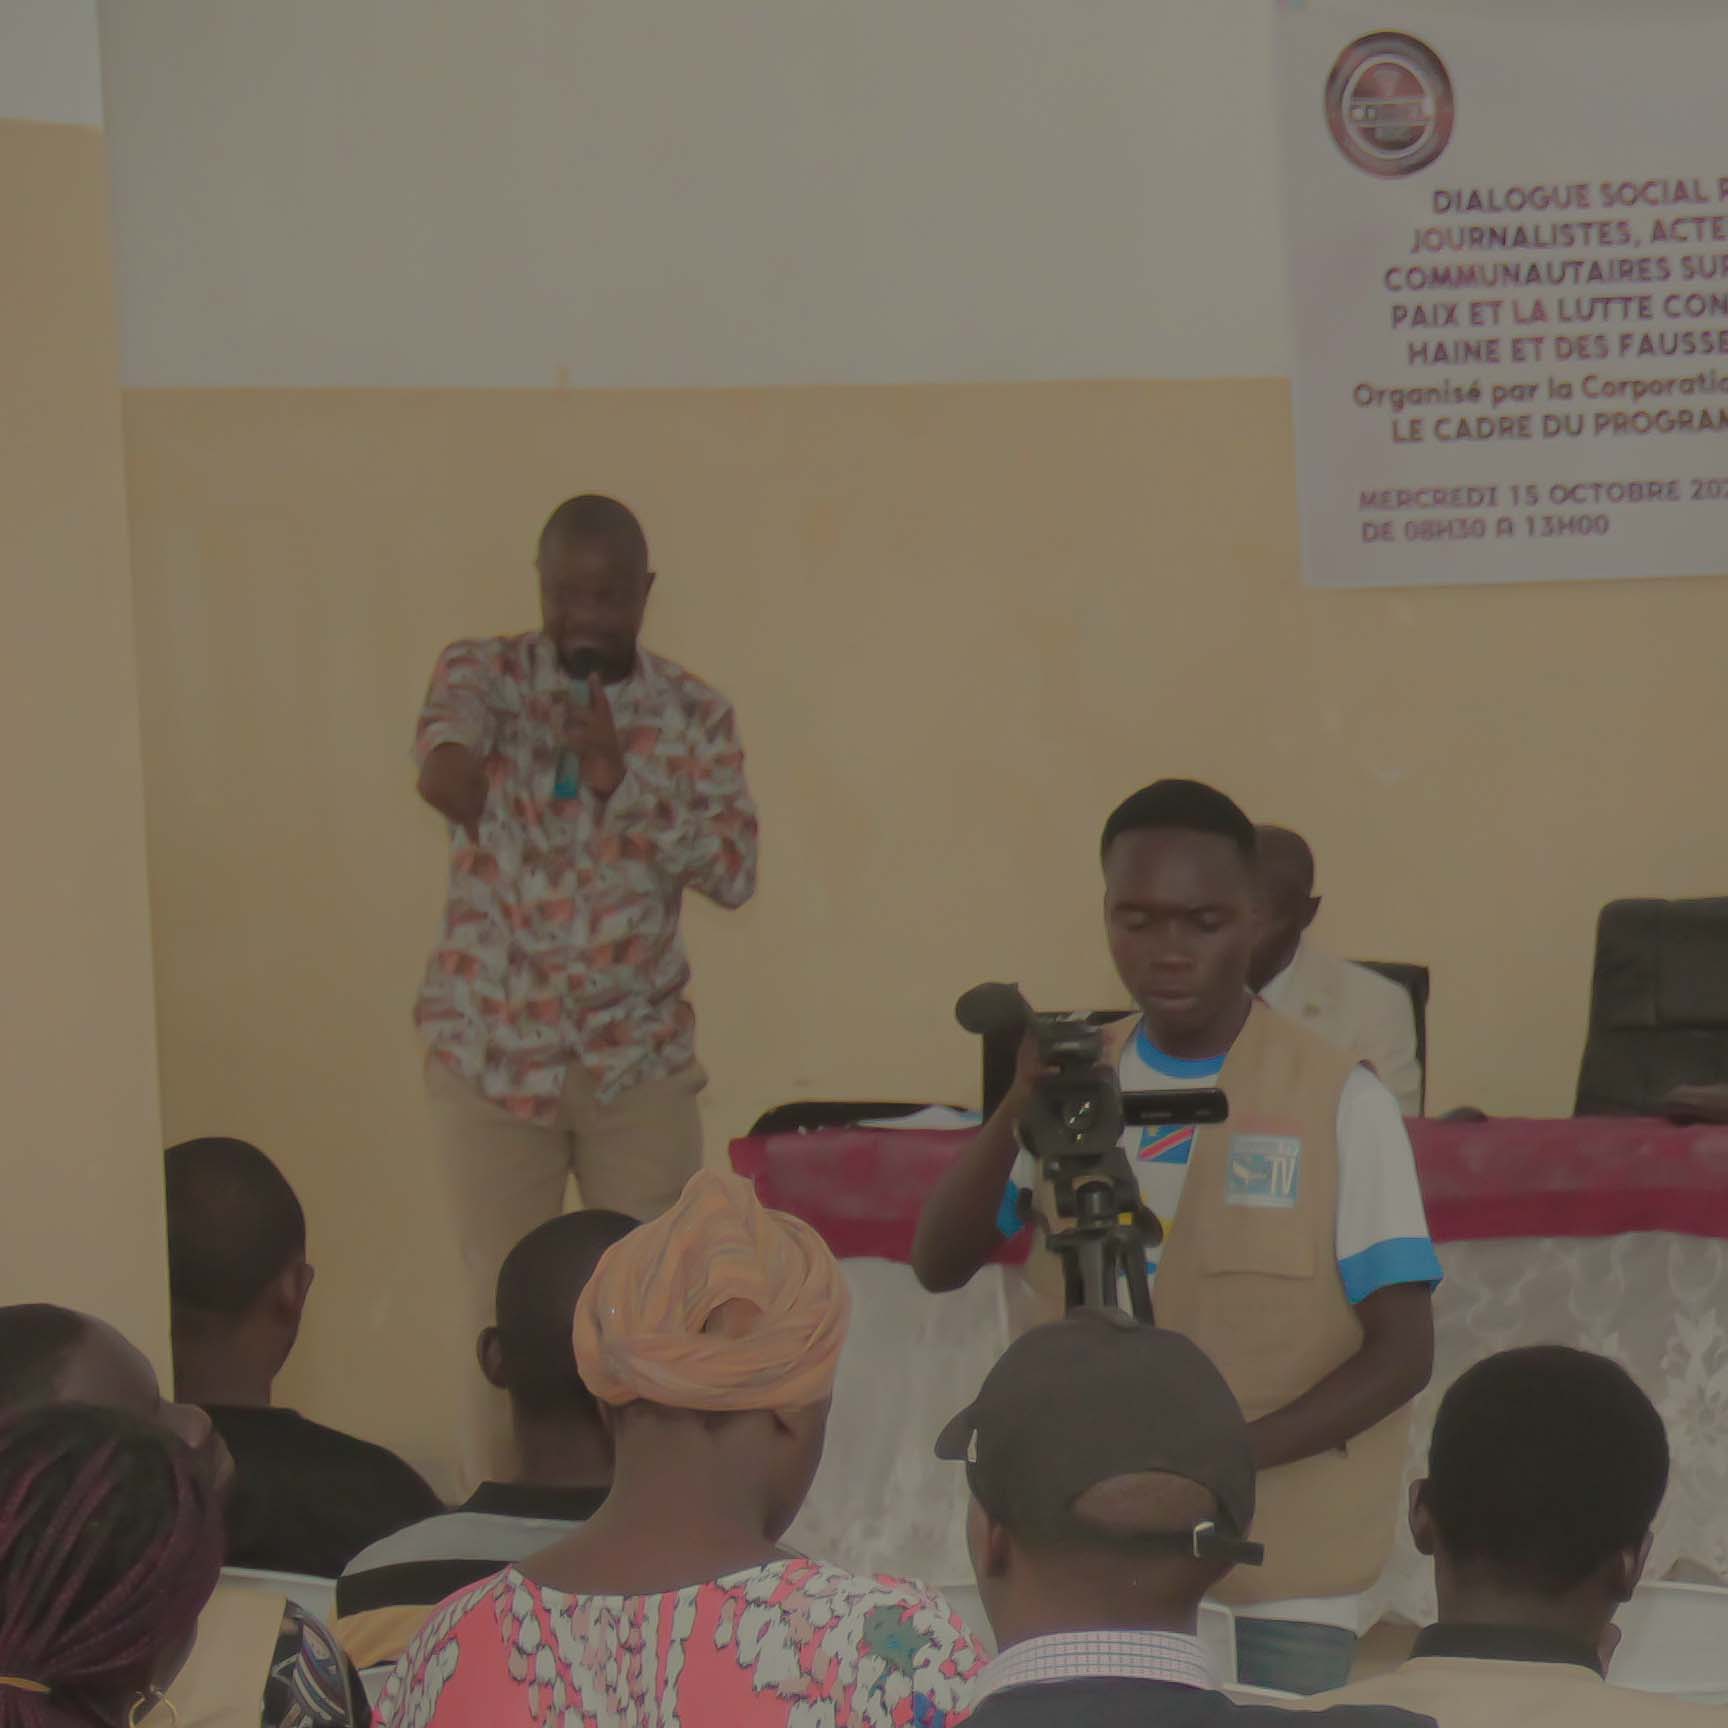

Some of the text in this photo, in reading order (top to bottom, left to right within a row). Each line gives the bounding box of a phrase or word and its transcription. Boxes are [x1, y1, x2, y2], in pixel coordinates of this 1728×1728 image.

[1432, 183, 1591, 215] DIALOGUE
[1599, 178, 1711, 209] SOCIAL
[1410, 219, 1641, 254] JOURNALISTES,
[1383, 255, 1672, 292] COMMUNAUTAIRES
[1391, 303, 1459, 329] PAIX
[1469, 299, 1505, 328] ET
[1511, 298, 1549, 325] LA
[1557, 294, 1654, 323] LUTTE
[1407, 337, 1501, 365] HAINE
[1510, 335, 1546, 364] ET
[1553, 333, 1611, 362] DES
[1352, 378, 1483, 414] Organisé
[1490, 383, 1540, 409] par
[1547, 376, 1574, 401] la
[1391, 417, 1425, 445] LE
[1433, 413, 1533, 443] CADRE
[1541, 413, 1585, 439] DU
[1359, 485, 1499, 511] MERCREDI
[1509, 483, 1540, 507] 15
[1548, 479, 1681, 506] OCTOBRE
[1361, 513, 1611, 544] DE 08H30 A 13H00
